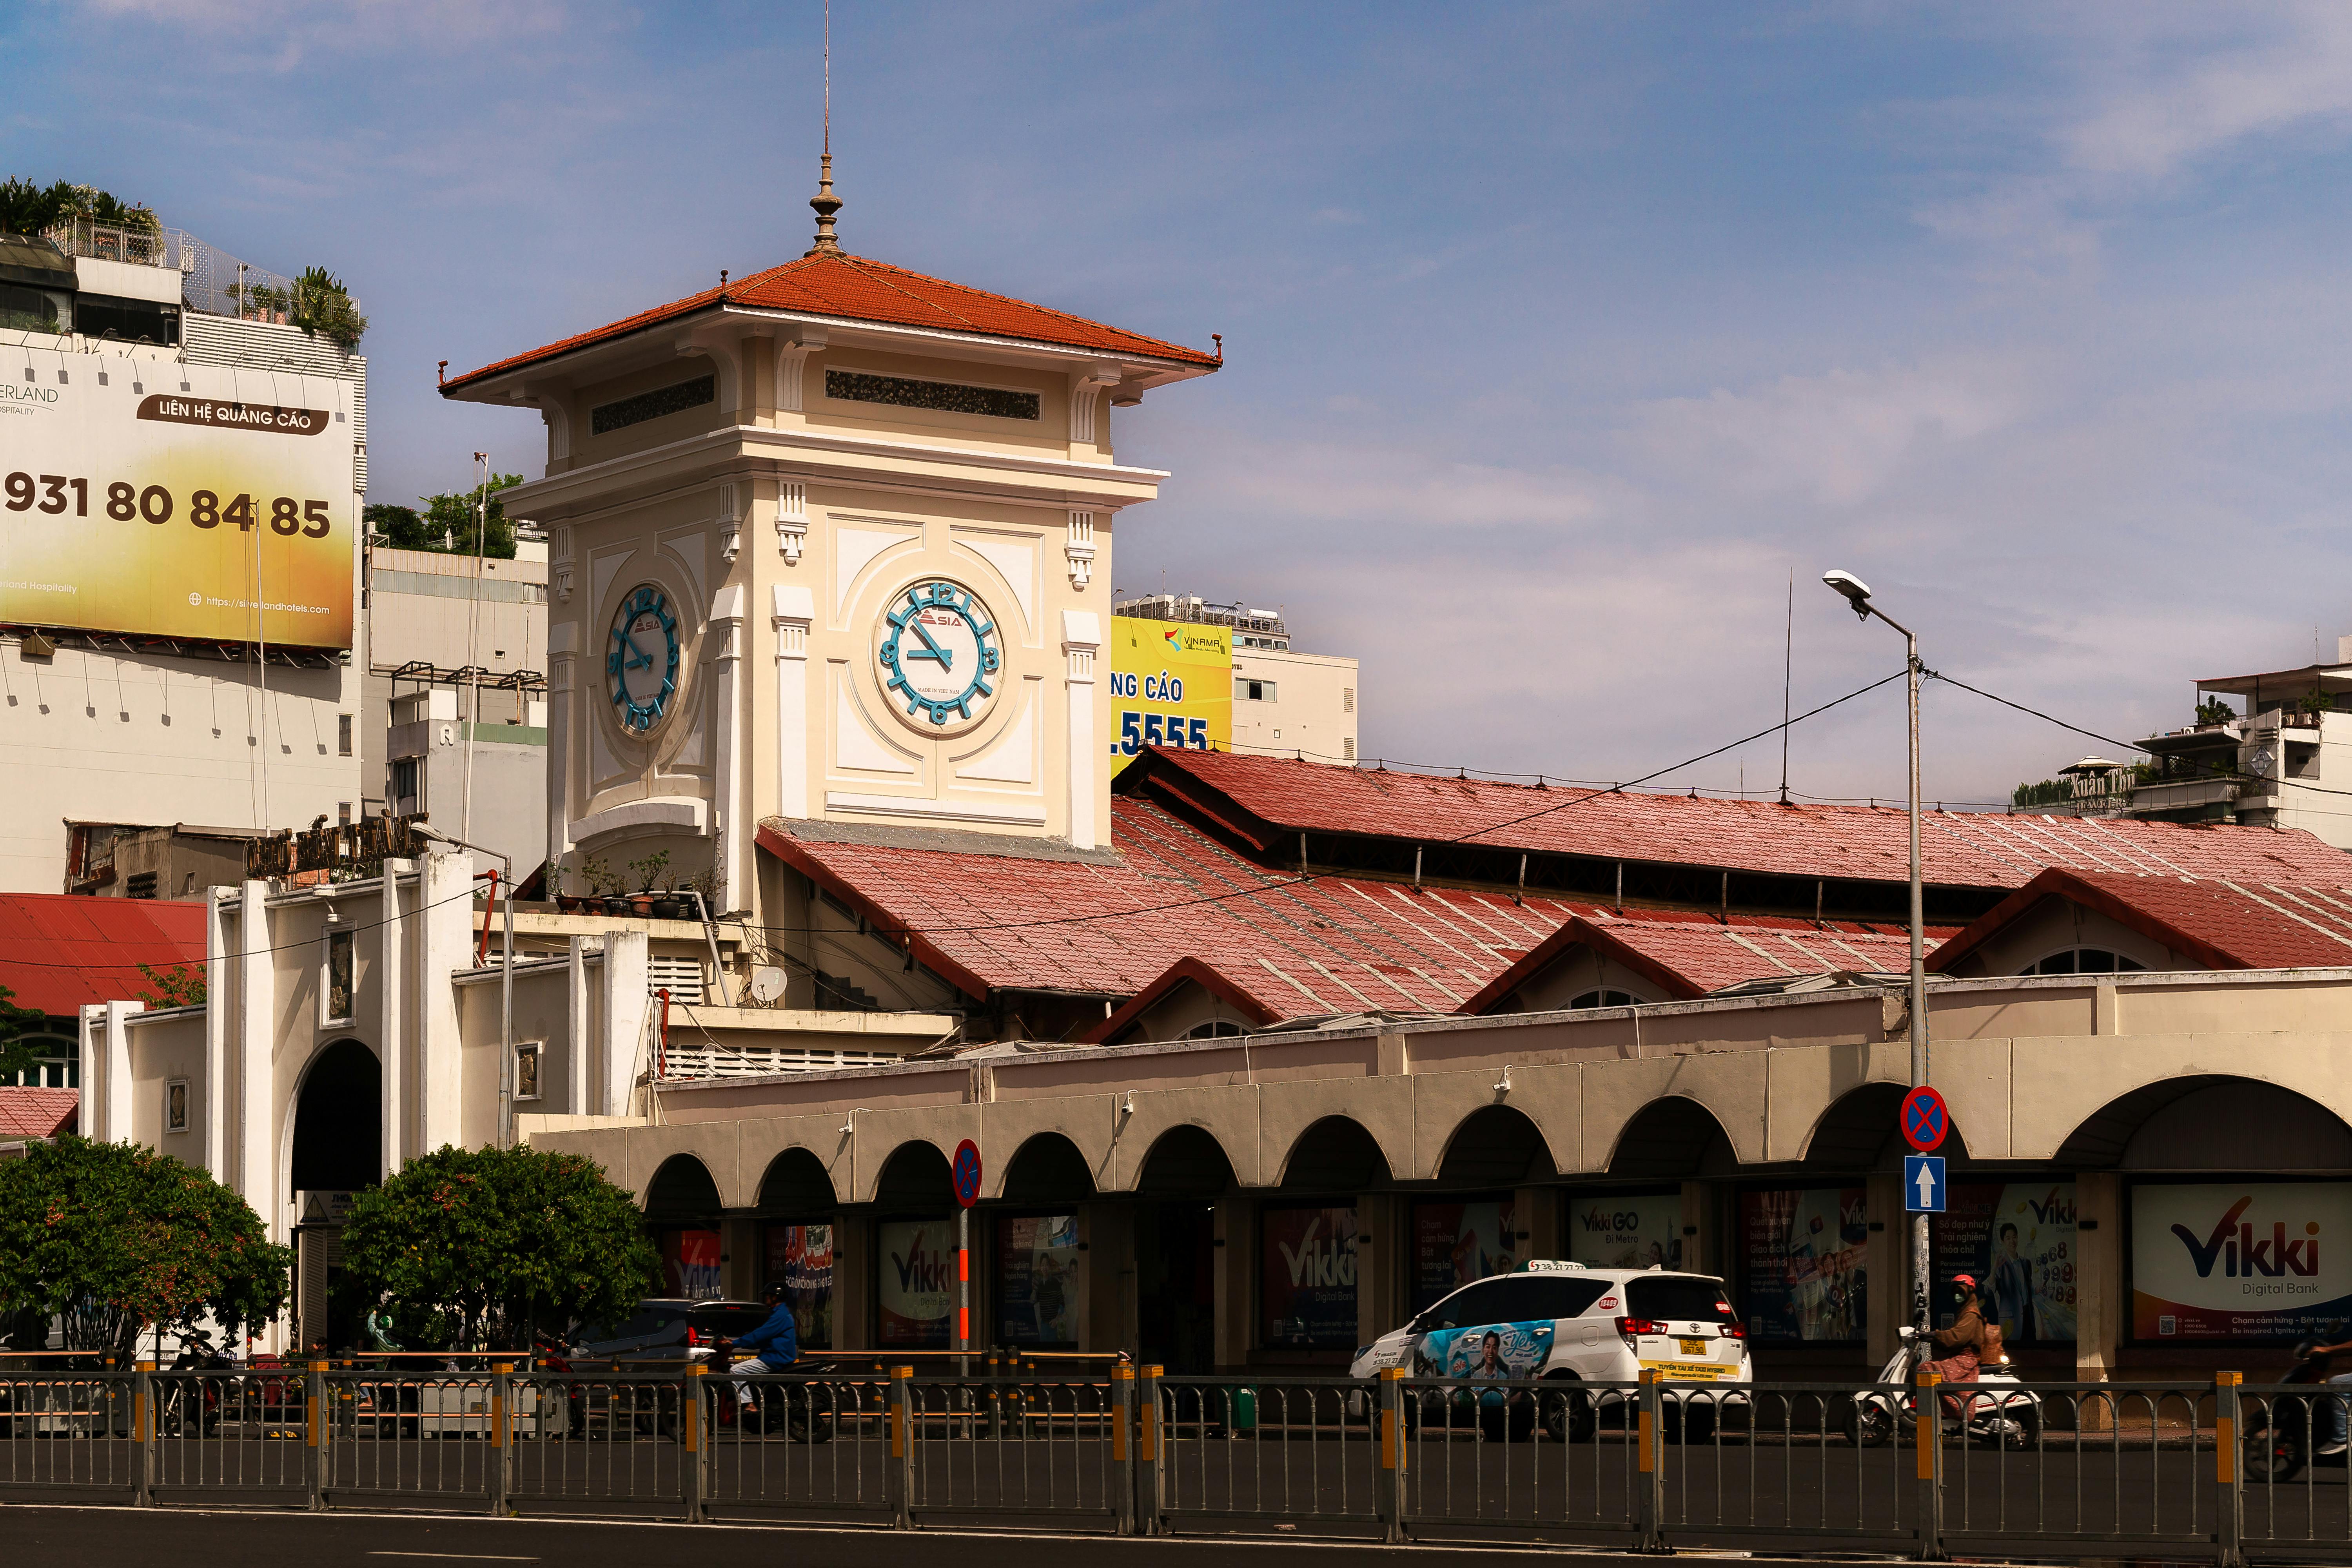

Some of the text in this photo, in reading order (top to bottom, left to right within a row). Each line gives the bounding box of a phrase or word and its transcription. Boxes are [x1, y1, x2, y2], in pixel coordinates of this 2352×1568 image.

[160, 399, 311, 428] LIÊN HỆ QUẢNG CÁO
[4, 472, 330, 539] 931 80 84 85
[30, 582, 77, 595] Hospitality
[930, 583, 956, 606] 12
[207, 597, 330, 614] https://silvelandhotels.com
[1184, 636, 1220, 647] VINAMA
[1145, 671, 1182, 702] CÁO
[1581, 1205, 1639, 1232] Vikki GO
[1939, 1218, 1950, 1229] Số
[1951, 1220, 1967, 1231] đẹp
[1969, 1220, 1984, 1228] như
[1606, 1234, 1639, 1244] Đi Metro
[1939, 1231, 1986, 1243] Trải nghiệm
[2171, 1195, 2320, 1278] Vikki
[1279, 1216, 1355, 1287] Vikki
[2043, 1261, 2077, 1283] 999
[1315, 1291, 1355, 1303] Digital Bank
[2242, 1282, 2319, 1296] Digital Bank
[2232, 1317, 2254, 1327] Chạm
[2274, 1316, 2293, 1325] hứng
